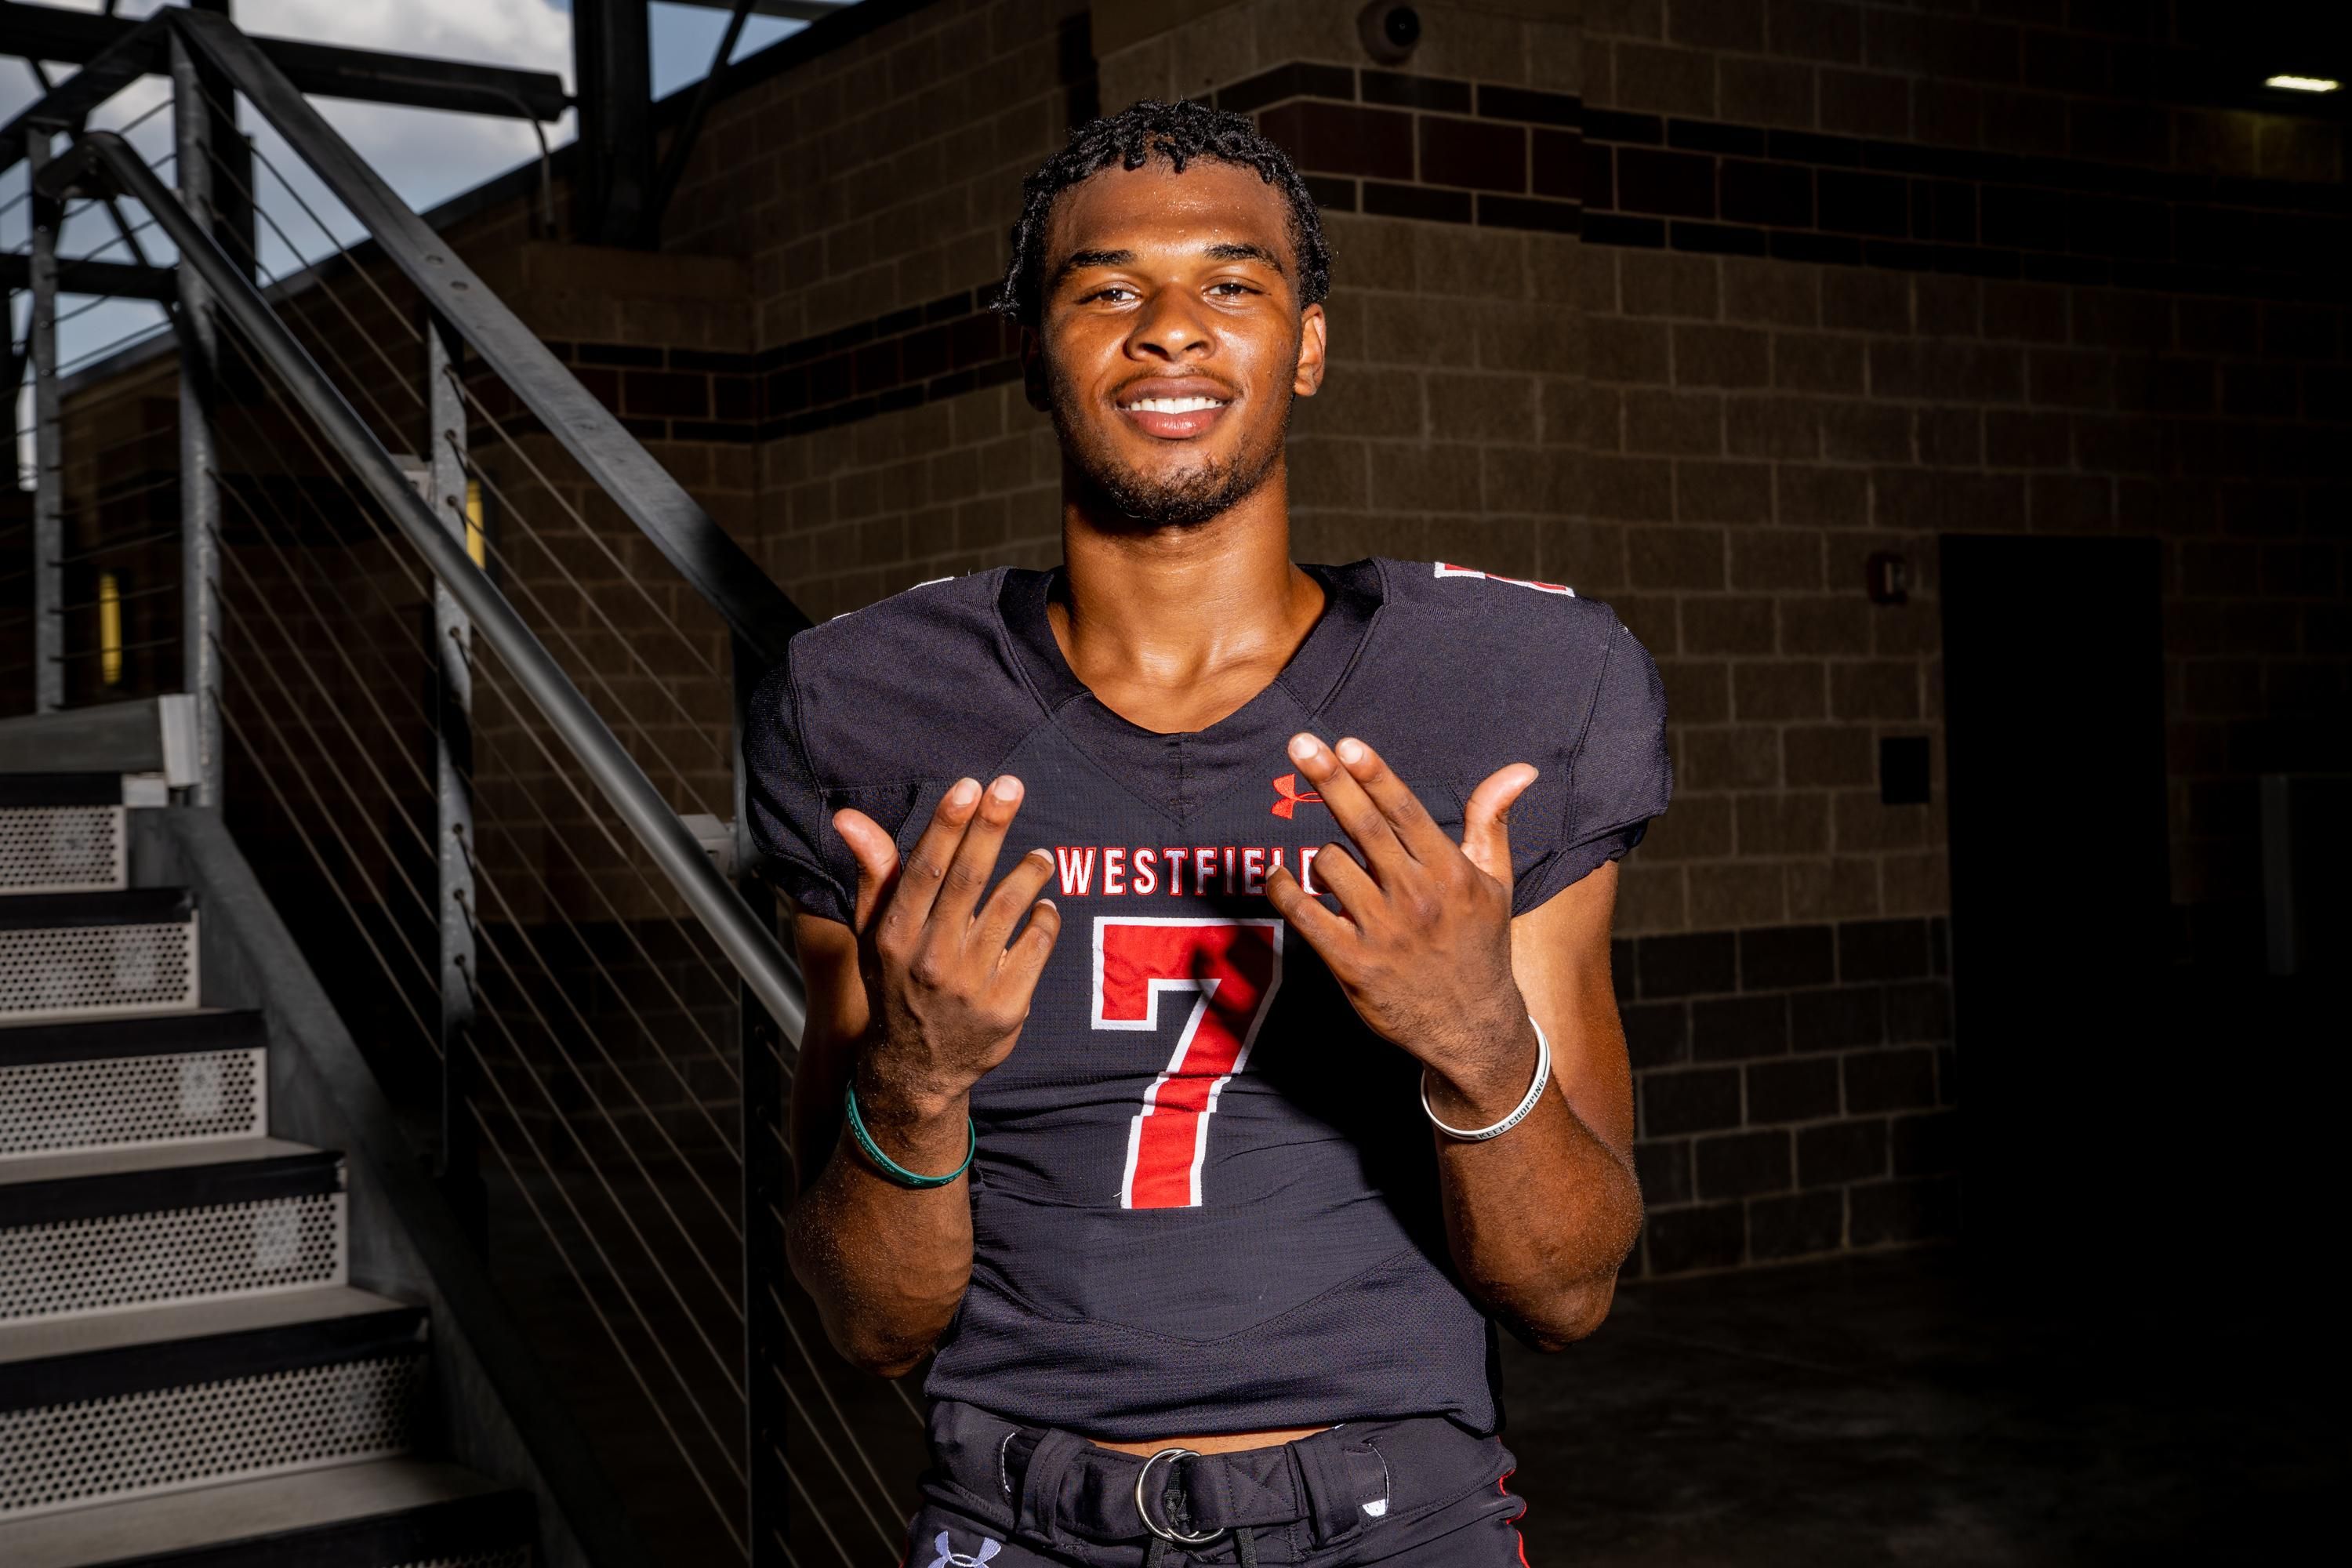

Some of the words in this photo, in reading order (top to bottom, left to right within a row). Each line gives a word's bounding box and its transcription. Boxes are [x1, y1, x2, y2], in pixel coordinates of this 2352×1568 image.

[1091, 916, 1284, 1209] 7
[1479, 1125, 1505, 1139] KEEP
[1508, 1079, 1544, 1126] CHOPPING
